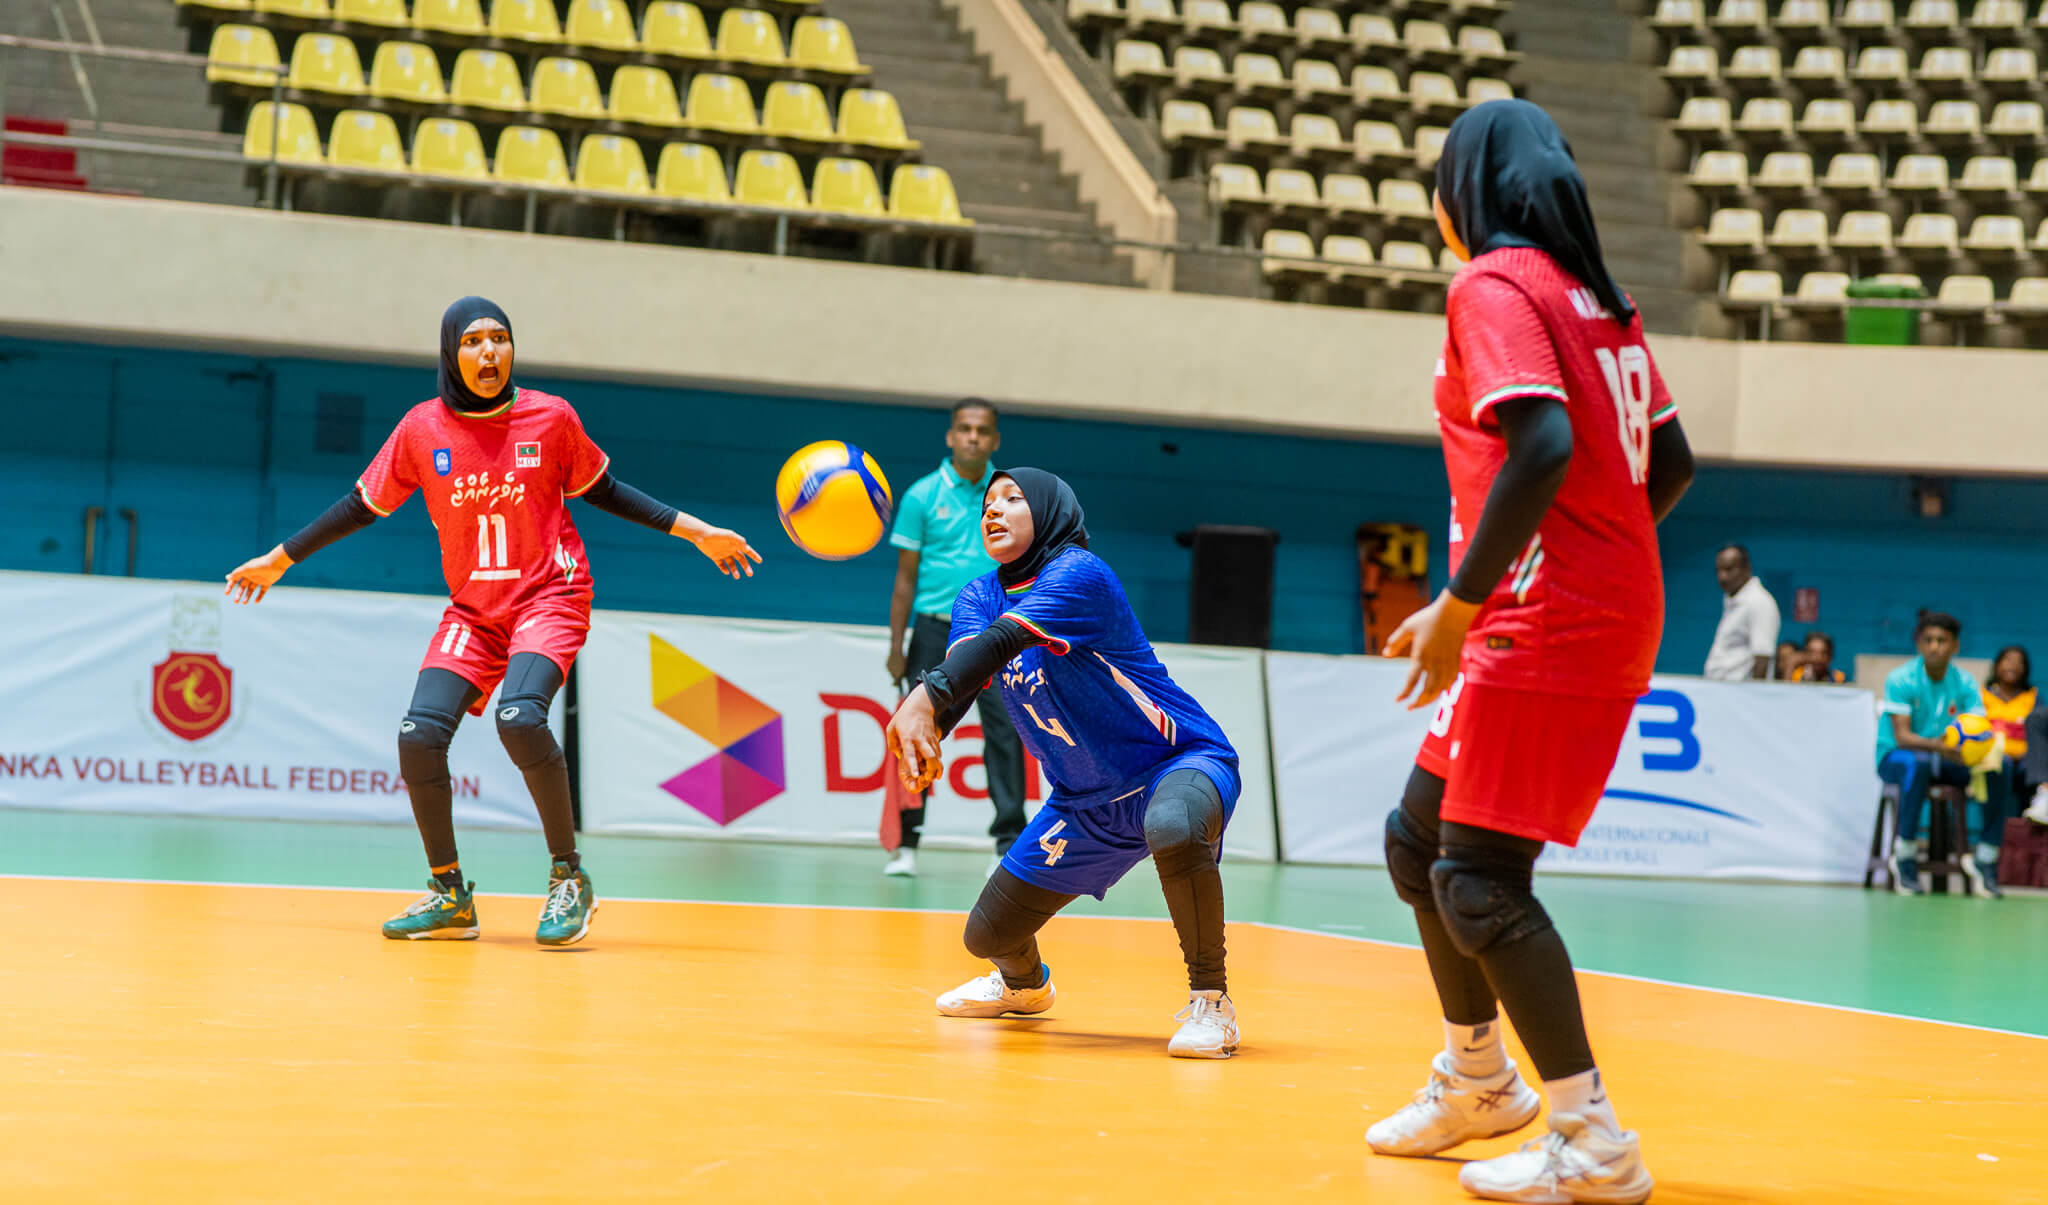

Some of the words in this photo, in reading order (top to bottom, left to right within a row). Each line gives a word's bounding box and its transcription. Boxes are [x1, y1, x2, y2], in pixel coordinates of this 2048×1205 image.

[1594, 345, 1652, 485] 18
[476, 513, 509, 569] 11
[440, 622, 472, 657] 11
[1021, 703, 1077, 747] 4
[72, 756, 278, 791] VOLLEYBALL
[289, 766, 480, 798] FEDERAN
[1039, 818, 1068, 867] 4
